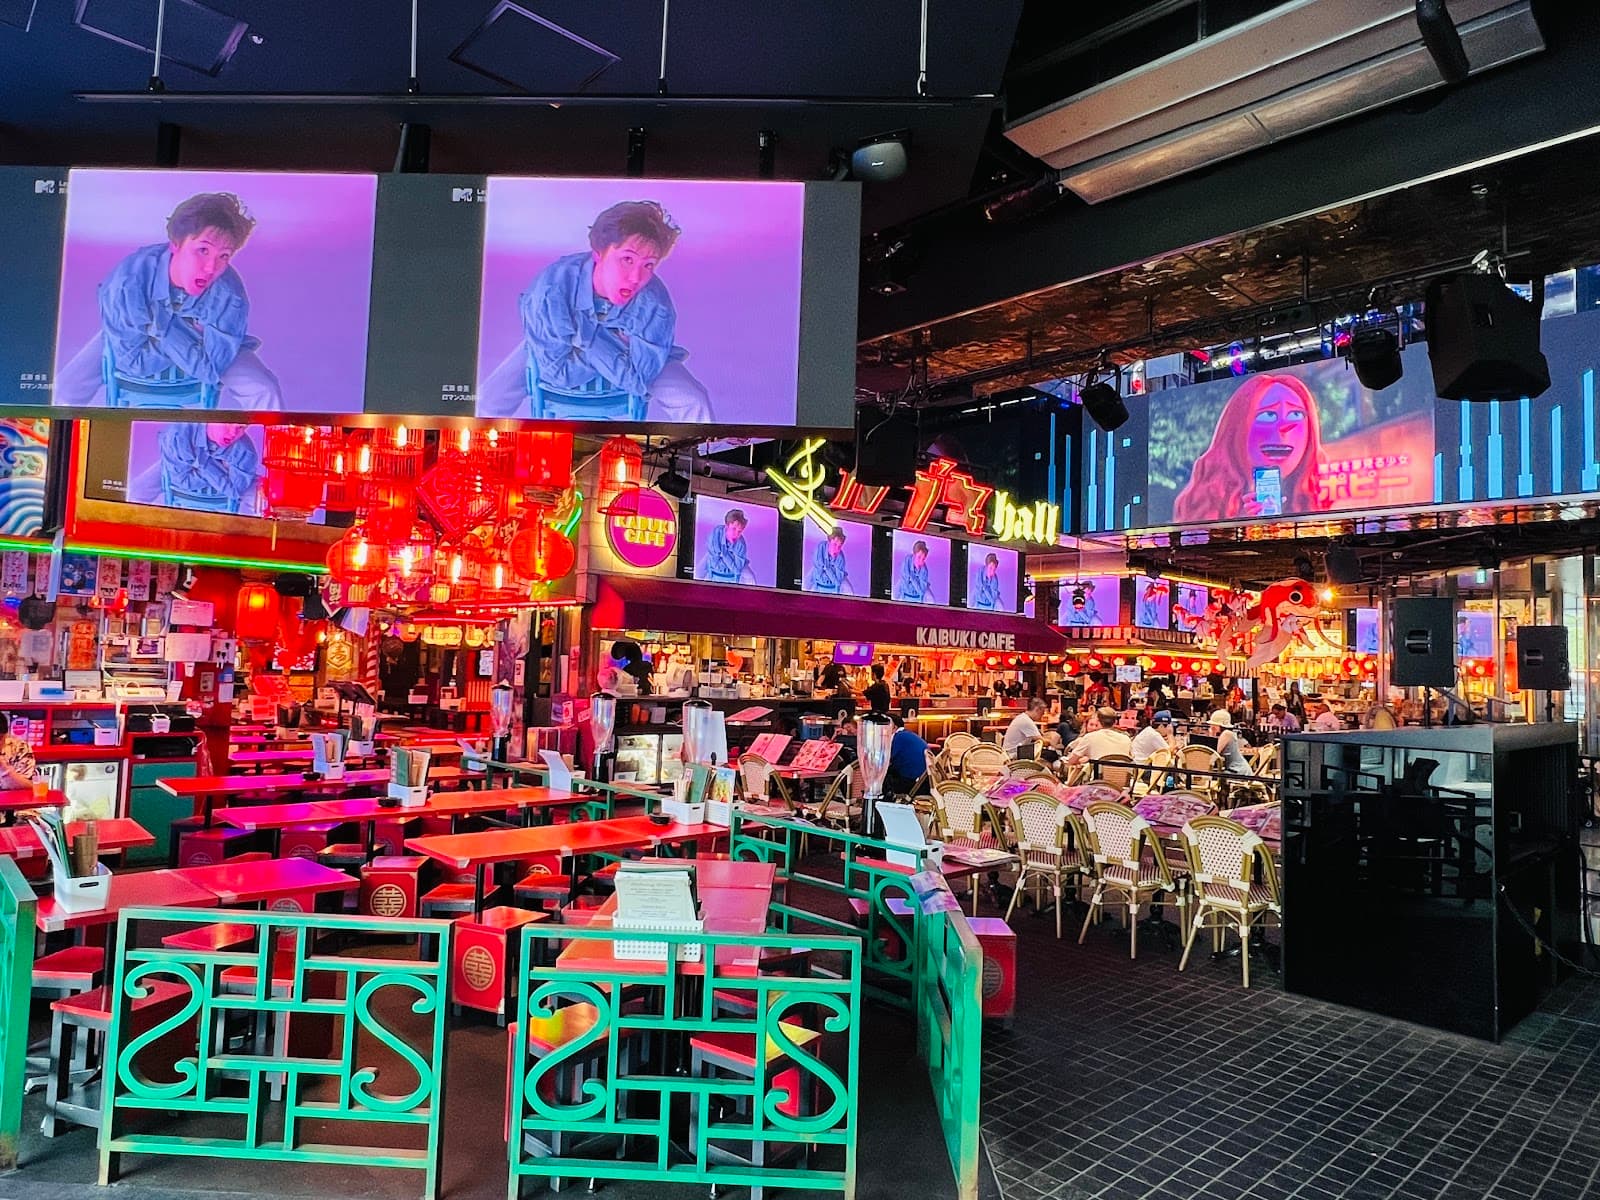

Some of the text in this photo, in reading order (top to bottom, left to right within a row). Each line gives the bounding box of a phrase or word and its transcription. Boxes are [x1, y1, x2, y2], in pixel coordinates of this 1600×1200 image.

[1318, 470, 1409, 501] ポピー
[614, 515, 676, 535] KABUKI
[992, 490, 1060, 546] hall
[623, 528, 666, 547] CAFE
[916, 626, 1016, 651] KABUKI CAFE
